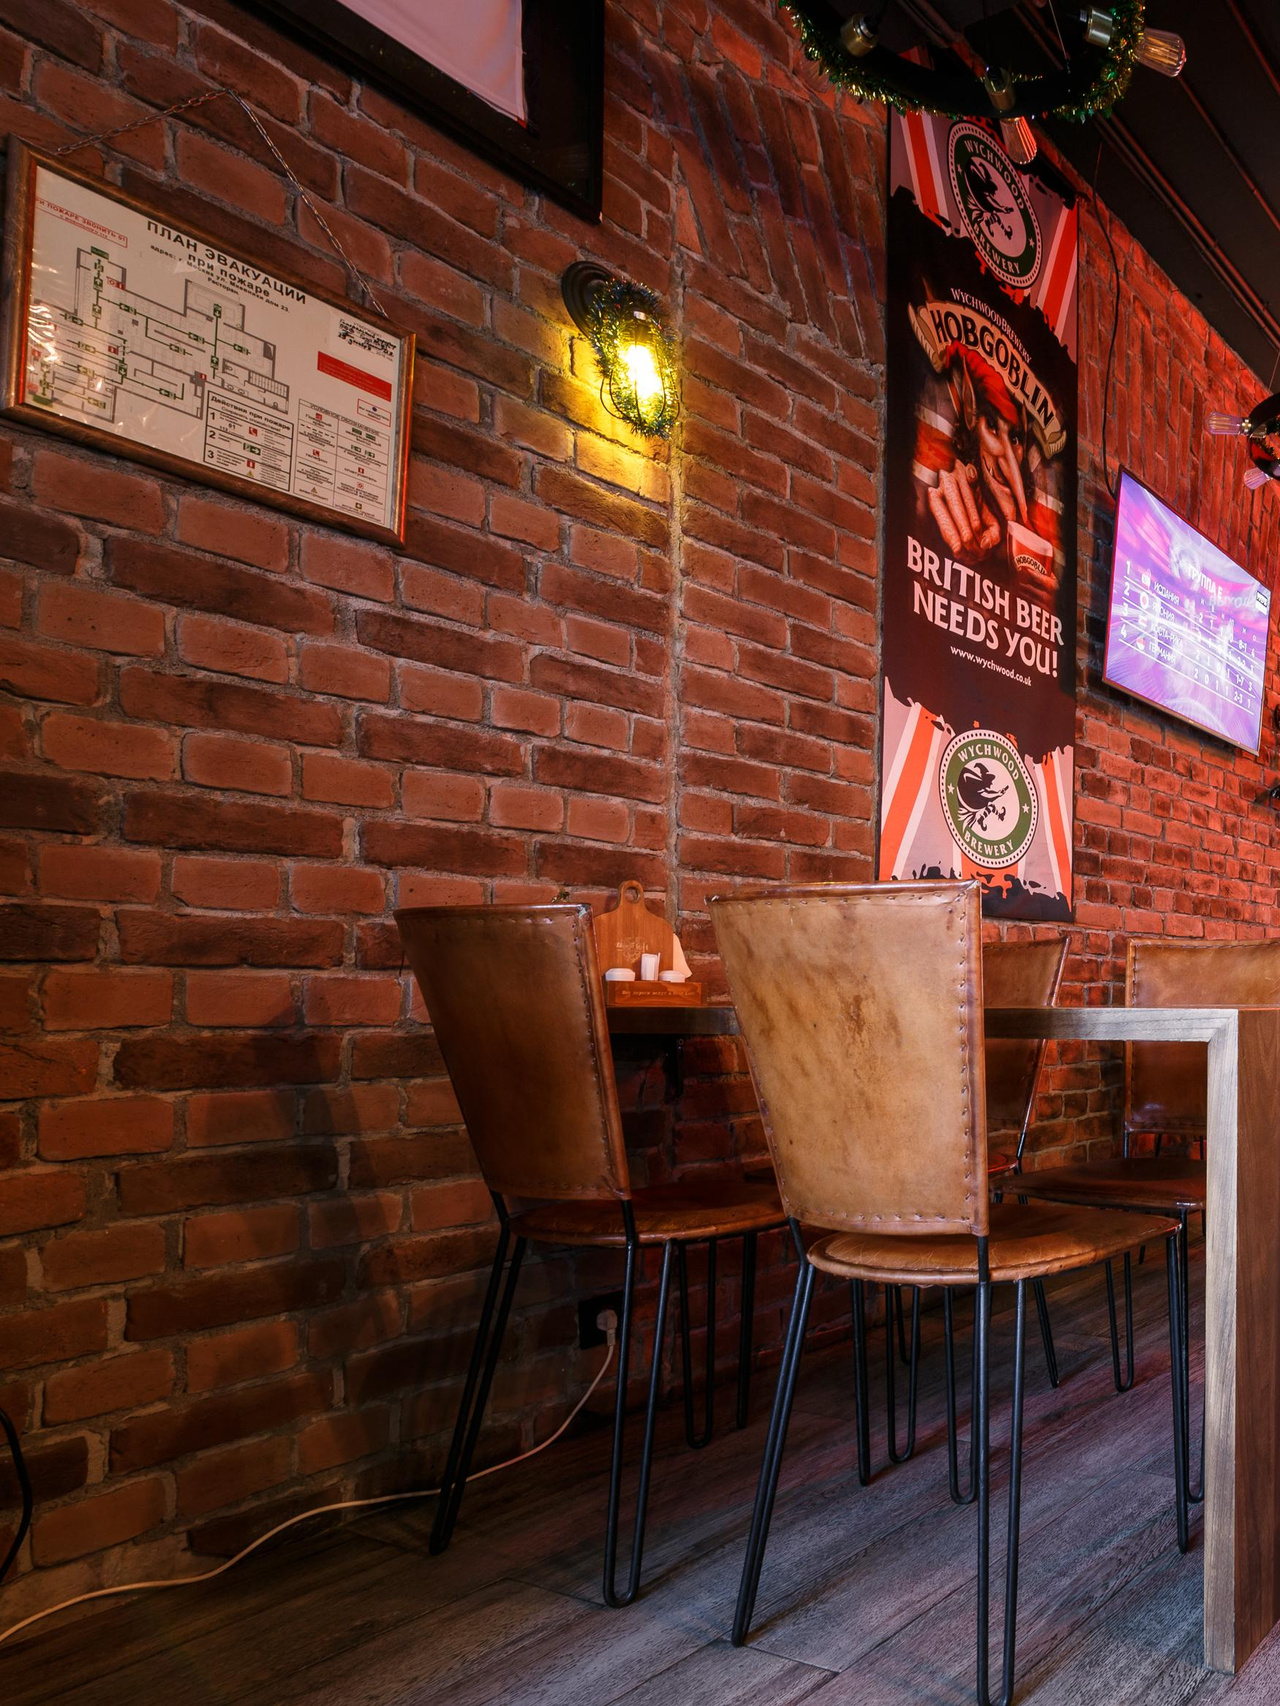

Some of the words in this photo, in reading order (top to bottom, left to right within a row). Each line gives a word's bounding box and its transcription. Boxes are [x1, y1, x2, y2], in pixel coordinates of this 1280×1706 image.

[964, 139, 1024, 210] WYCHWOOD
[147, 220, 198, 252] ПЛАН
[205, 249, 306, 304] ЭВАКУАЦИИ
[973, 222, 1020, 276] BREWERY
[188, 254, 214, 271] при
[220, 267, 269, 296] пожаре
[951, 288, 1001, 326] WYCHWOOD
[1001, 318, 1032, 363] BREWERY
[930, 310, 1055, 427] HOBGOBLIN
[209, 430, 216, 439] 2
[210, 412, 215, 420] 1
[208, 450, 214, 459] 3
[1126, 561, 1130, 574] 1
[907, 536, 1010, 618] BRITISH
[1016, 598, 1064, 646] BEER
[1124, 582, 1130, 596] 2
[913, 580, 998, 650] NEEDS
[1004, 627, 1058, 678] YOU!
[1123, 603, 1128, 616] 3
[1120, 624, 1127, 638] 4
[950, 644, 1032, 687] www.wychwood.co.uk
[957, 744, 1019, 781] WYCHWOOD
[963, 830, 1014, 858] BREWERY
